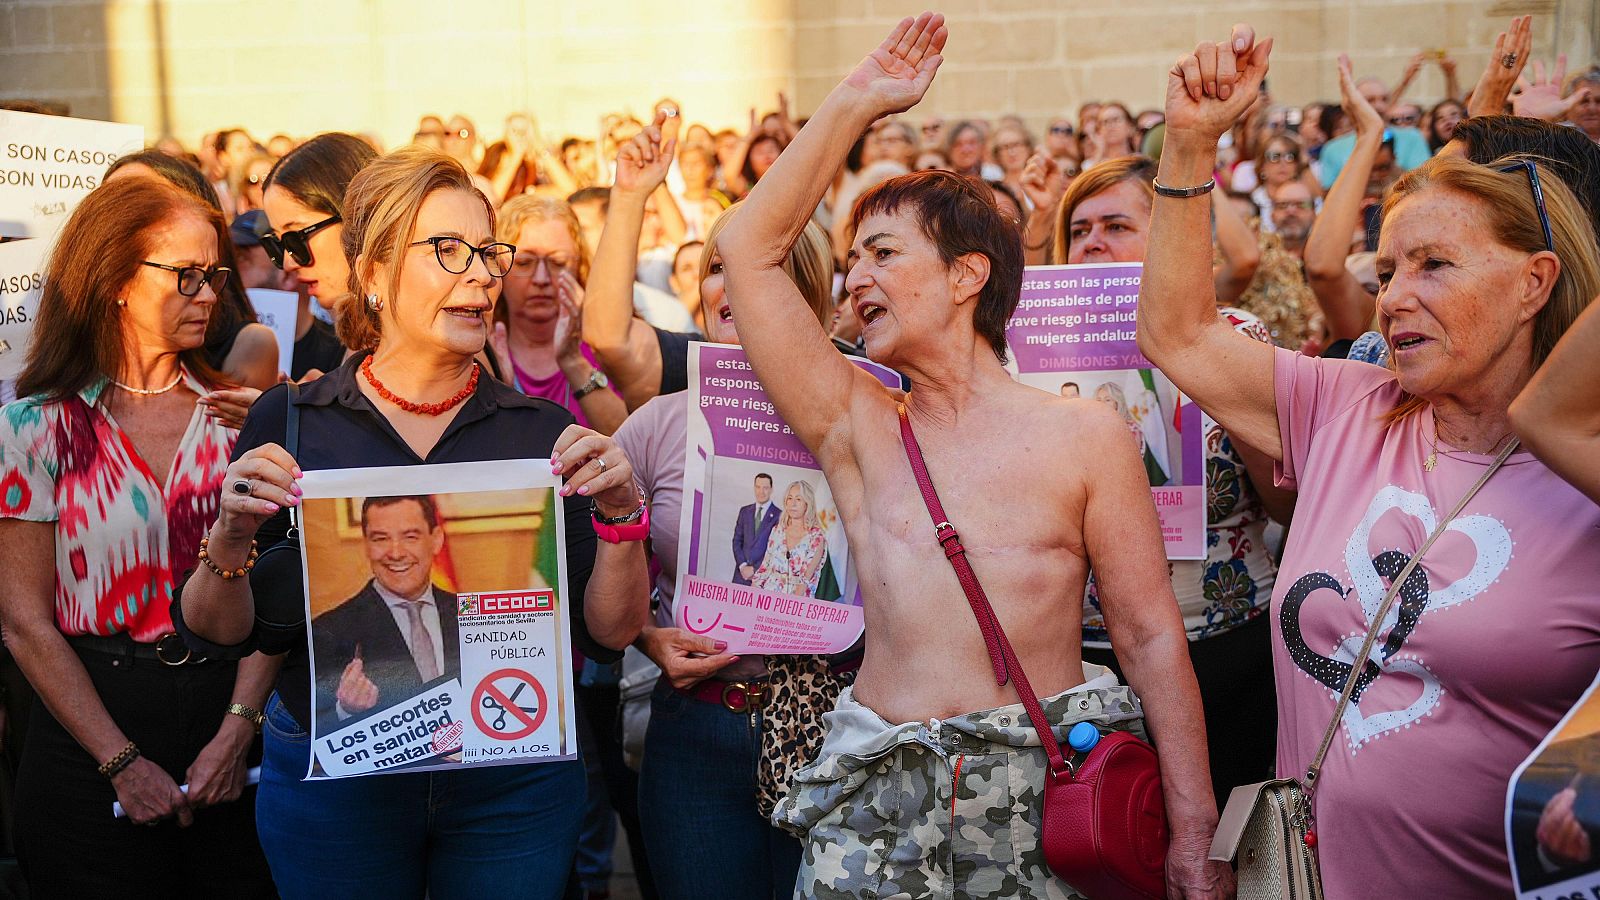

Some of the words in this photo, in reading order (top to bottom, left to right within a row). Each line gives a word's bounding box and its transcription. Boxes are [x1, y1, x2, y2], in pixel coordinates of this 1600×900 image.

[7, 143, 47, 161] SON
[1053, 279, 1078, 289] son
[1081, 276, 1101, 288] las
[1016, 294, 1093, 311] sponsables
[1095, 293, 1112, 305] de
[1041, 314, 1082, 328] riesgo
[1085, 311, 1098, 324] la
[1100, 309, 1137, 323] salud
[1026, 332, 1081, 347] mujeres
[1083, 329, 1137, 343] andaluz
[1039, 355, 1118, 369] DIMISIONES
[705, 376, 764, 392] respons
[700, 395, 739, 408] grave
[725, 416, 780, 433] mujeres
[735, 443, 814, 465] DIMISIONES
[484, 596, 536, 611] CCOO
[687, 580, 728, 602] NUESTRA
[731, 588, 753, 607] VIDA
[755, 594, 772, 611] NO
[773, 600, 806, 617] PUEDE
[805, 603, 849, 625] ESPERAR
[497, 612, 521, 620] sanidad
[464, 630, 527, 644] SANIDAD
[490, 645, 546, 660] PÚBLICA
[326, 730, 367, 754] Los
[370, 692, 452, 737] recortes
[343, 749, 370, 765] en
[373, 710, 453, 755] sanidad
[481, 747, 504, 756] NO
[508, 746, 517, 754] A
[521, 744, 550, 753] LOS
